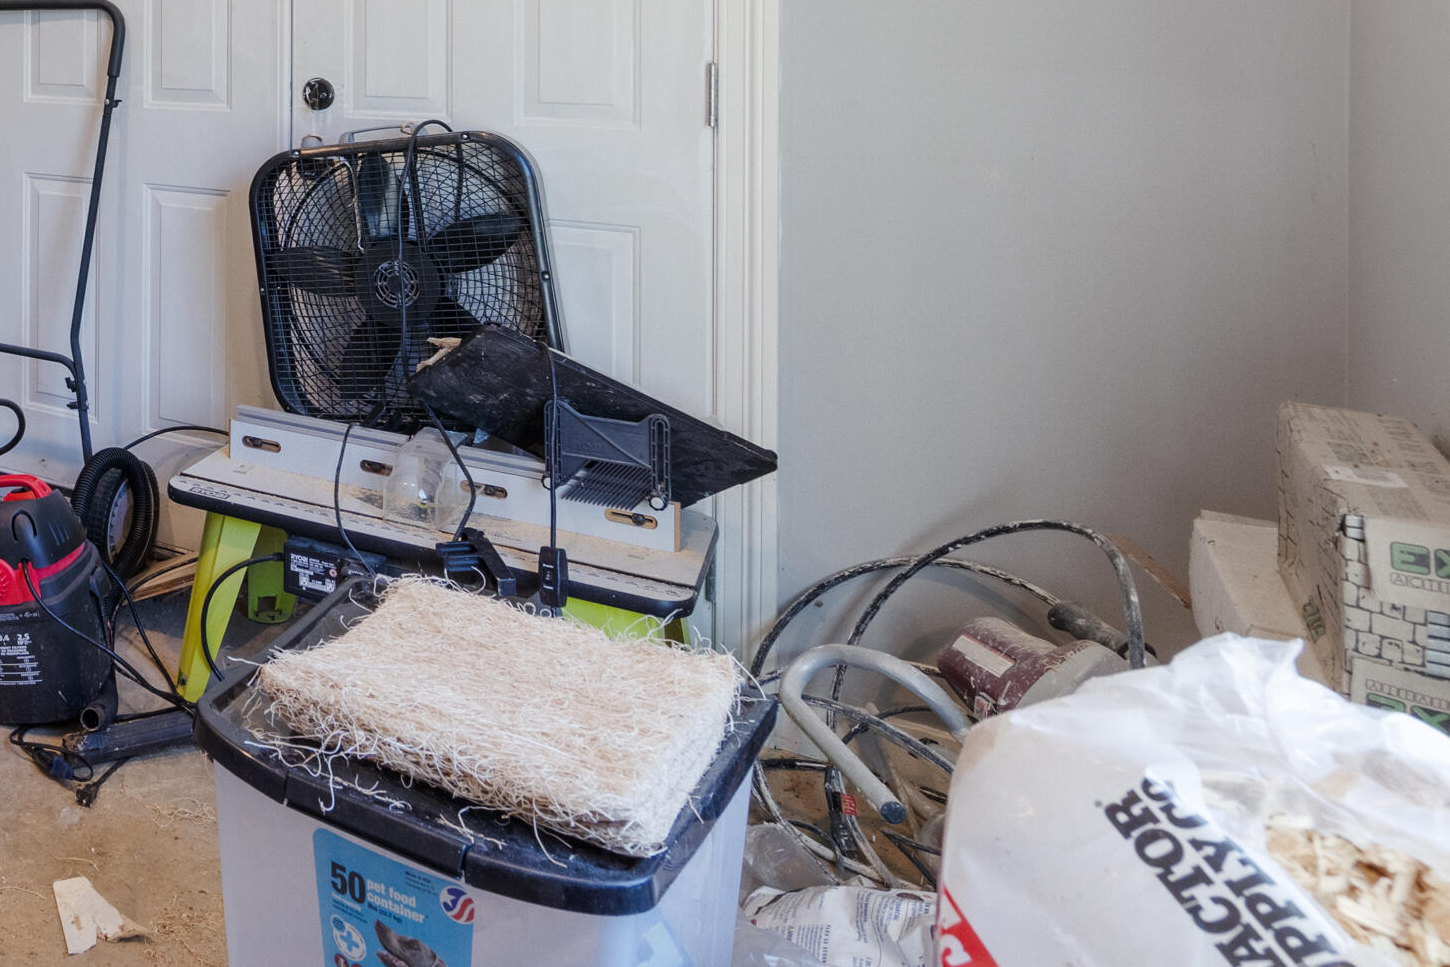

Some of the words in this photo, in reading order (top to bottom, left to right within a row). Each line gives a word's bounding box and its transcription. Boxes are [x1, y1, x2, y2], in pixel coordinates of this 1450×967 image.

[331, 861, 366, 904] 50
[366, 879, 386, 895] pet
[389, 886, 417, 908] food
[366, 892, 425, 923] container
[1188, 836, 1356, 967] PPLY
